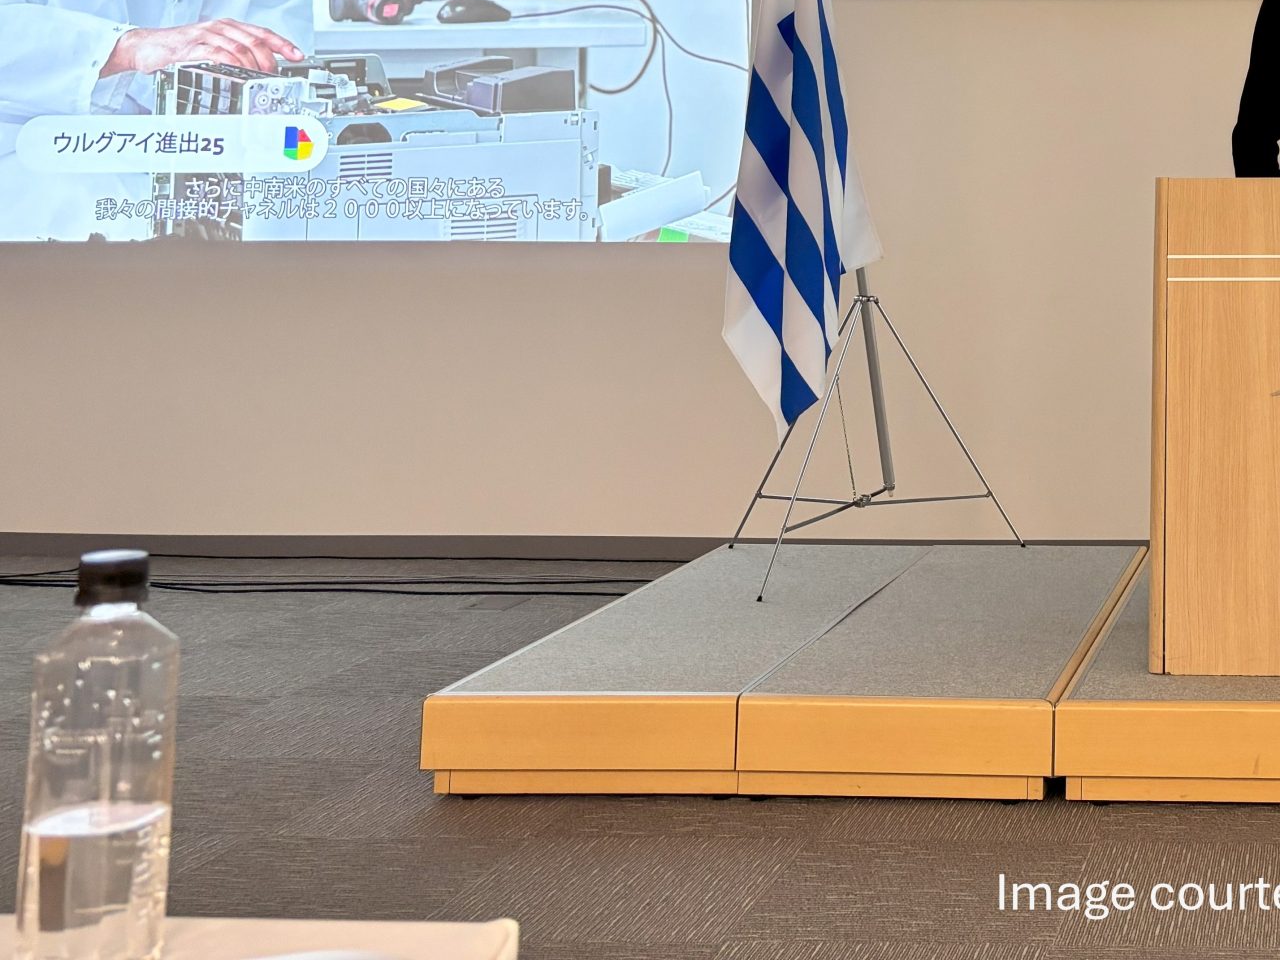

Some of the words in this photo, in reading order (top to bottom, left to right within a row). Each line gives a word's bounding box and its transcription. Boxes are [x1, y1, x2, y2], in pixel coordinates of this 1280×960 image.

[53, 130, 225, 157] ウルグアイ進出25
[184, 176, 506, 199] さらに中南米のすべての国々にある
